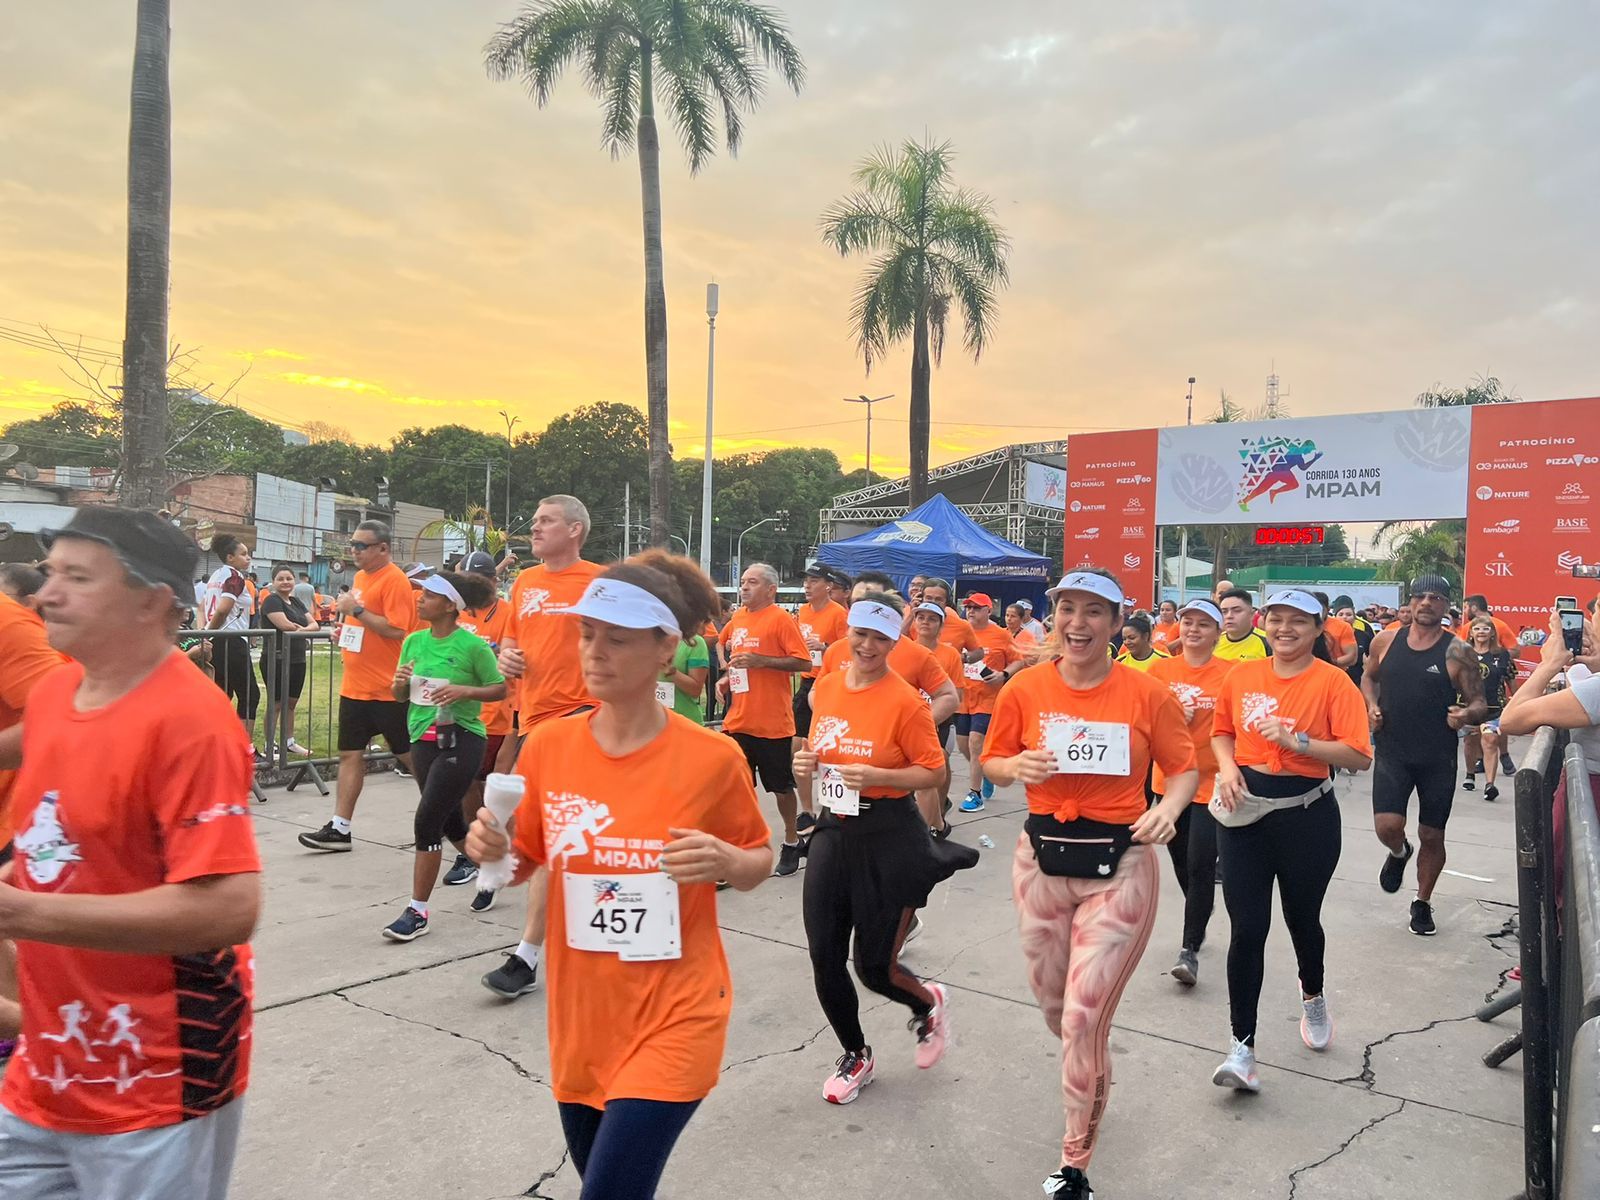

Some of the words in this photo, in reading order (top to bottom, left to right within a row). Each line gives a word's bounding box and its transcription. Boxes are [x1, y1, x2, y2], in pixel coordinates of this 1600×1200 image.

[1499, 437, 1575, 447] PATROCÍNIO
[1085, 460, 1136, 469] PATROCÍNIO
[1493, 462, 1528, 470] MANAUS
[1583, 456, 1599, 464] GO
[1305, 470, 1339, 481] CORRIDA
[1341, 469, 1357, 479] 130
[1358, 468, 1380, 478] ANOS
[1305, 481, 1381, 499] MPAM
[1494, 490, 1530, 498] NATURE
[1557, 518, 1588, 527] BASE
[1123, 526, 1144, 534] BASE
[1256, 527, 1324, 545] 00:00:57
[1485, 562, 1514, 577] STK
[838, 744, 873, 758] MPAM
[1067, 743, 1108, 762] 697
[821, 781, 844, 799] 810
[593, 850, 664, 870] MPAM
[589, 908, 647, 934] 457
